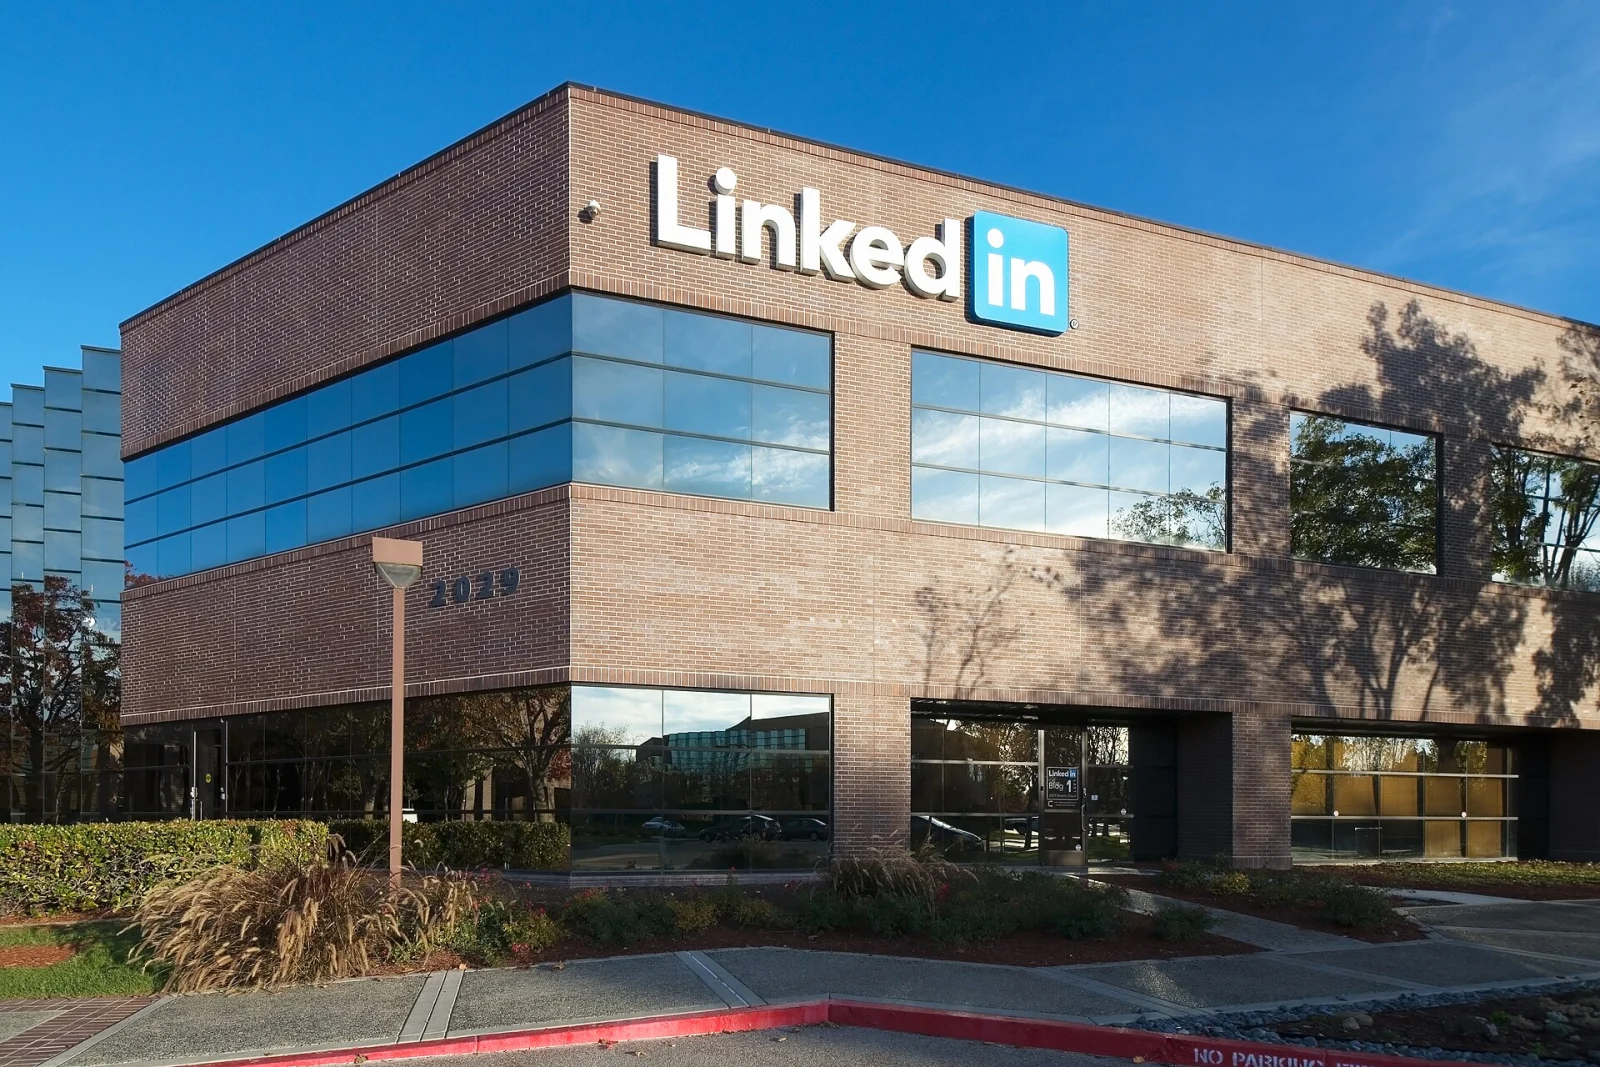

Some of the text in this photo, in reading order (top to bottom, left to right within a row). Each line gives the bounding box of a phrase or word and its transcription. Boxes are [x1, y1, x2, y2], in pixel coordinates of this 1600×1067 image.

[656, 153, 961, 301] Linked
[430, 566, 520, 608] 2029
[1049, 780, 1072, 792] Bldg 1
[1193, 1047, 1224, 1065] NO
